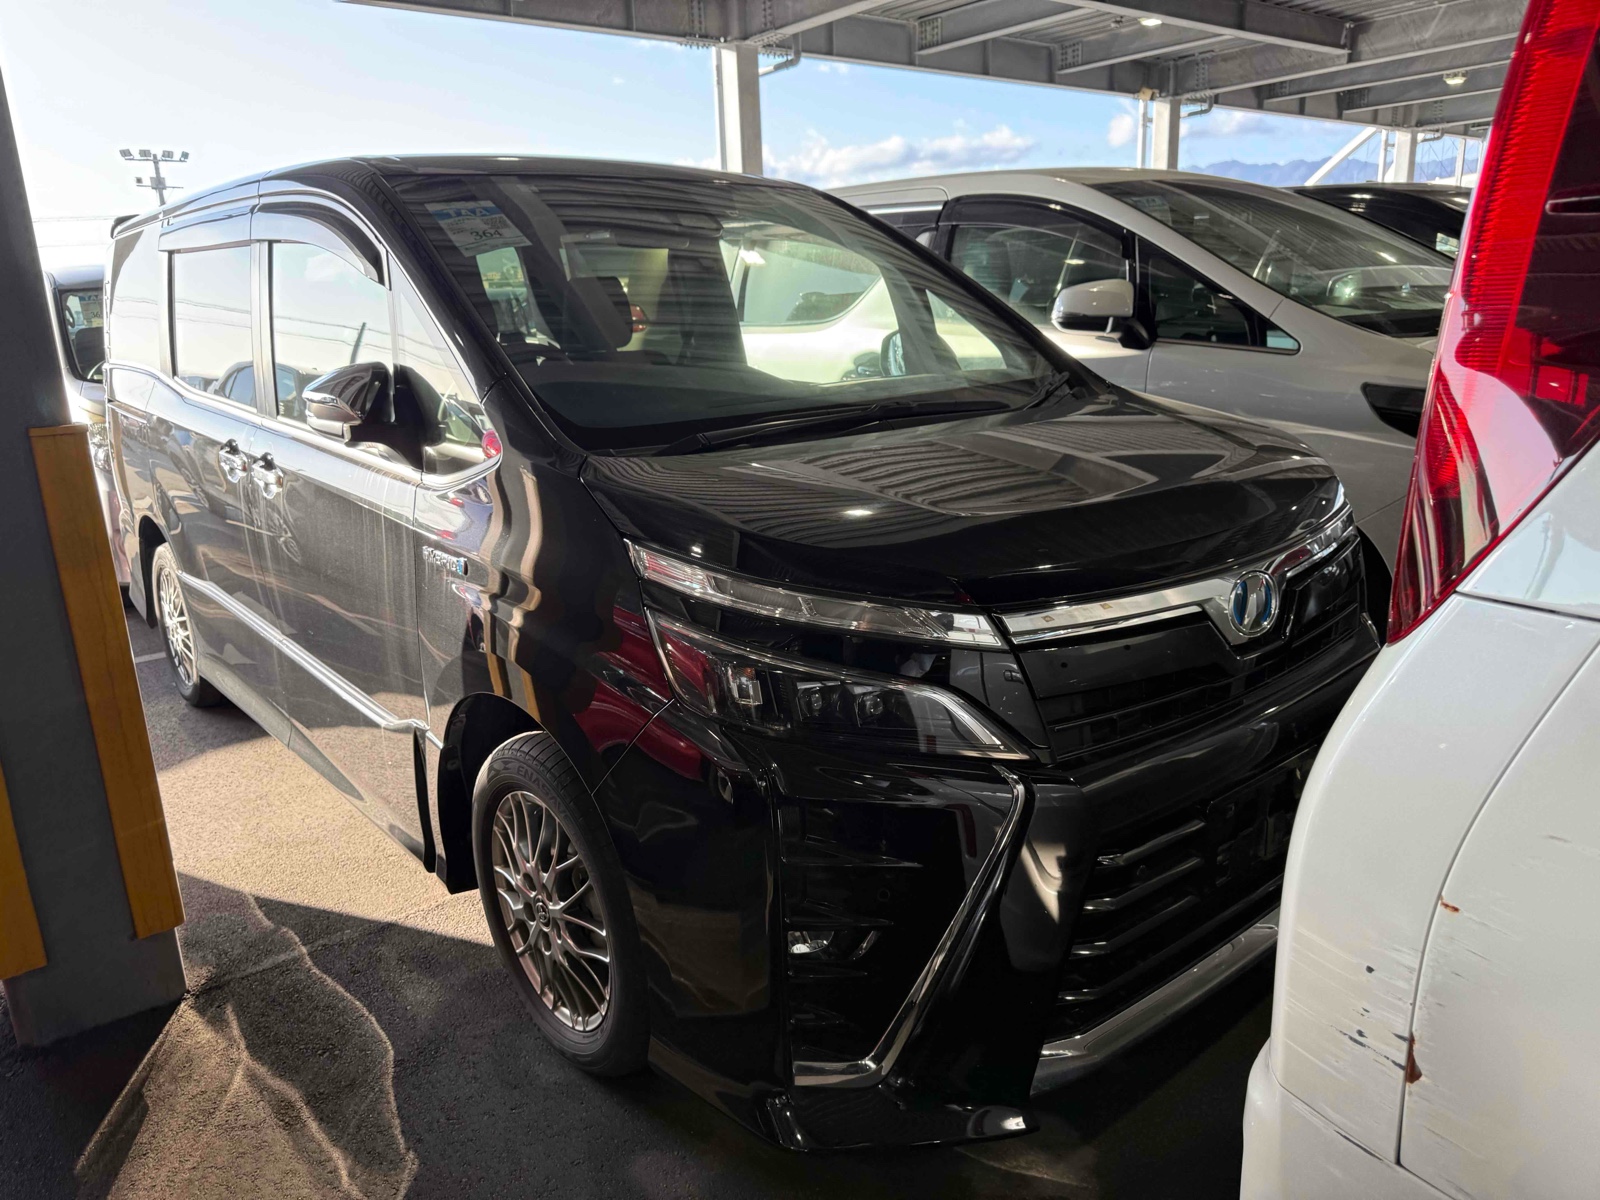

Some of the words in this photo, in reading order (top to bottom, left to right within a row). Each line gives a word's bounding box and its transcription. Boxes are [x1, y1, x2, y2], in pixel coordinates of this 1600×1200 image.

[443, 208, 490, 218] TAA
[470, 229, 503, 241] 364
[517, 766, 574, 824] ENASAVE
